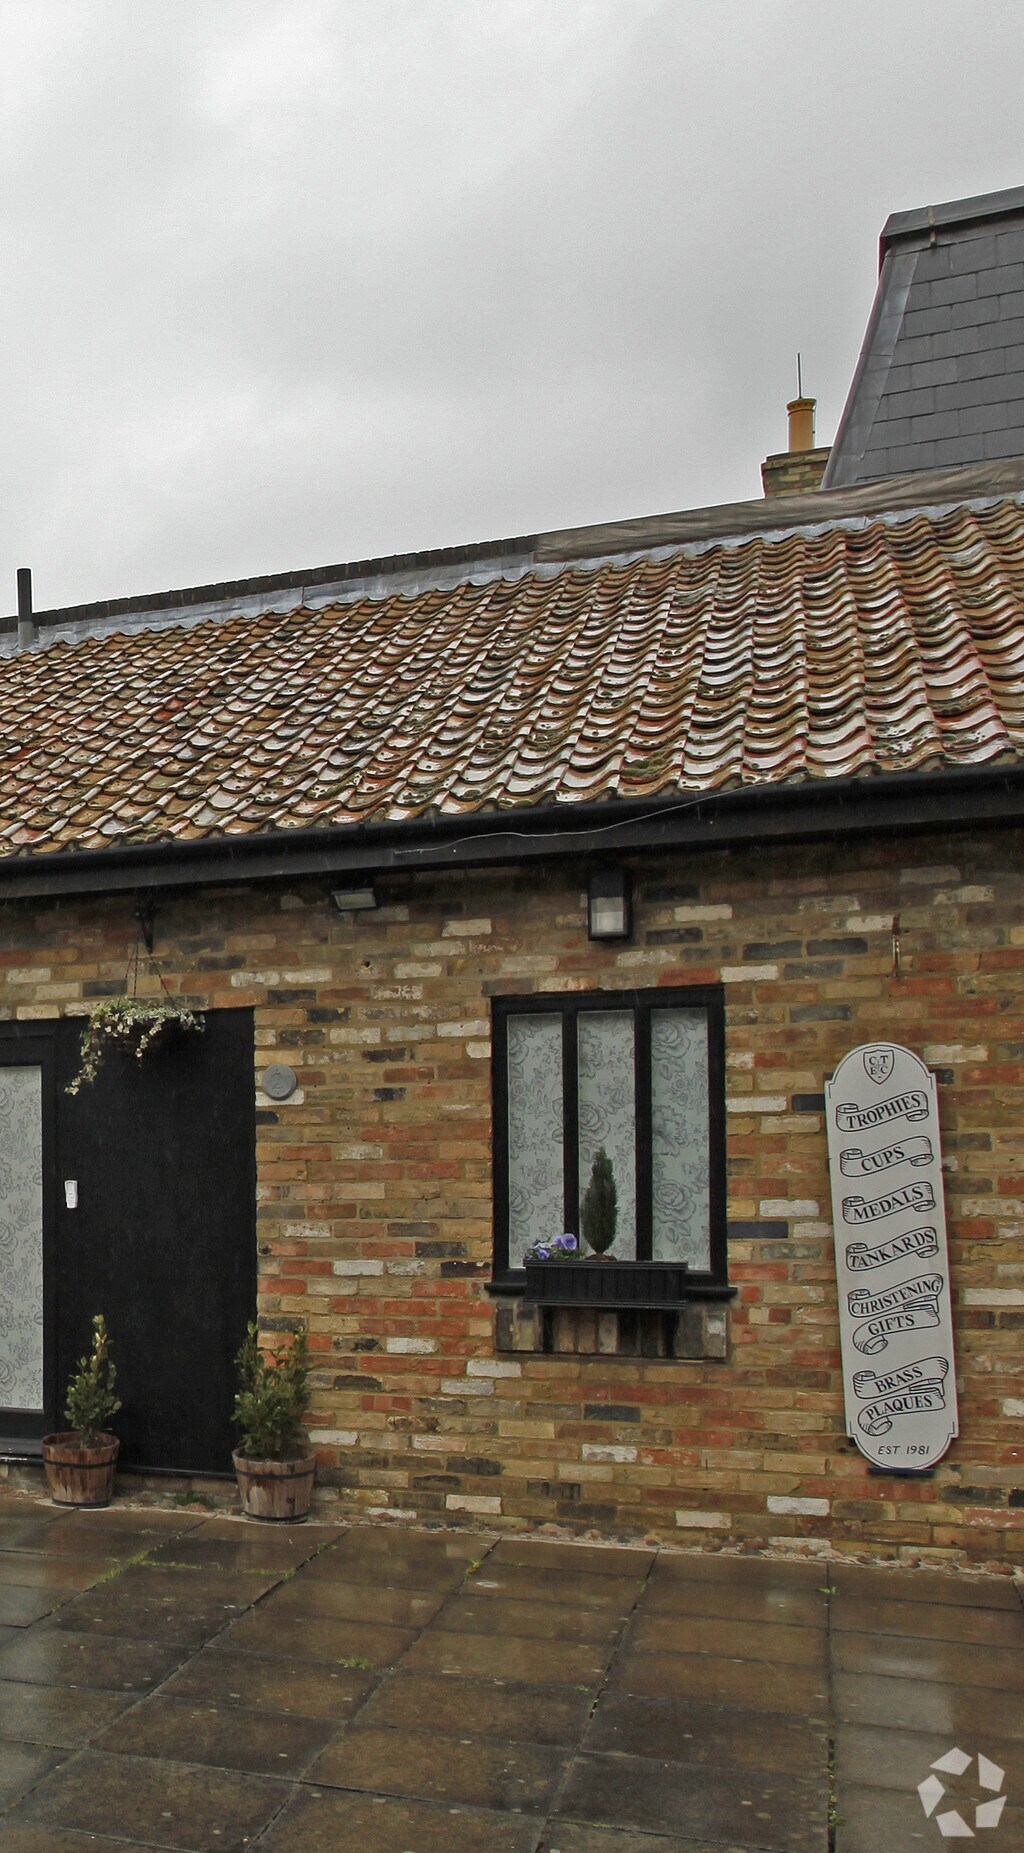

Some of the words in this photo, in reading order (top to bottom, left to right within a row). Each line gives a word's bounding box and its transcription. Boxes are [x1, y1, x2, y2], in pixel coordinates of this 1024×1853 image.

[846, 1094, 921, 1128] TROPHIES
[861, 1146, 905, 1172] CUPS
[853, 1185, 924, 1221] MEDALS
[849, 1229, 935, 1268] TANKARDS
[851, 1279, 941, 1314] CHRISTENING
[868, 1314, 915, 1336] GIFTS
[874, 1366, 923, 1393] BRASS
[865, 1394, 933, 1421] PLAQUES
[906, 1445, 930, 1455] 1981
